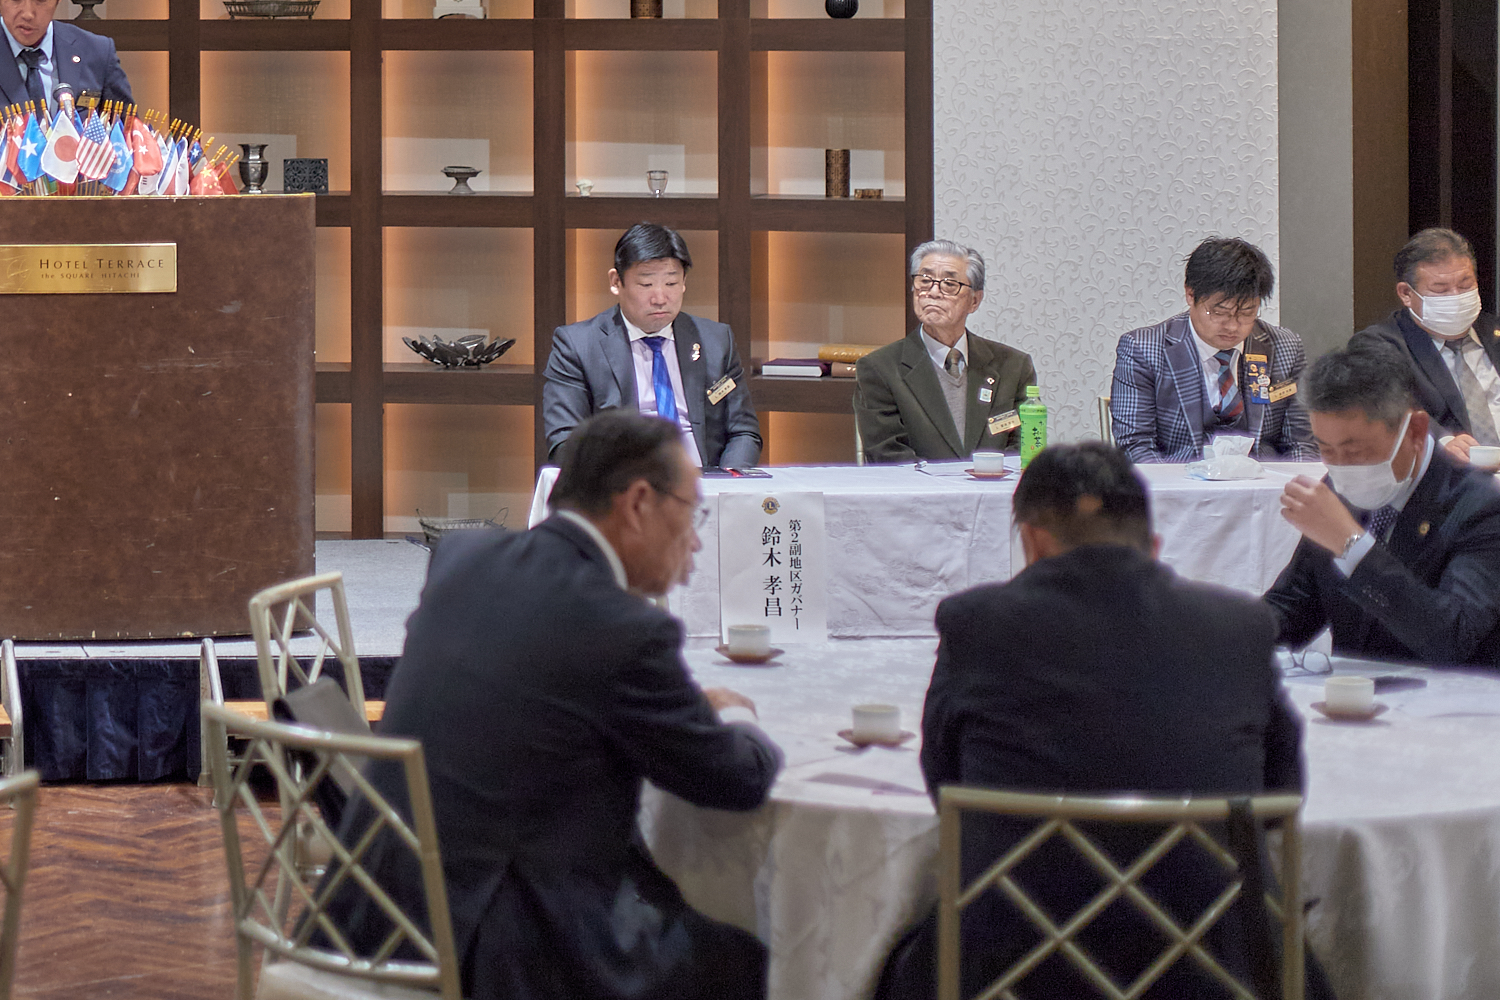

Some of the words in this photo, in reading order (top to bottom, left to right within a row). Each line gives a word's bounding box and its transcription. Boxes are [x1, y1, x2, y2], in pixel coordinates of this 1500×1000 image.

[39, 258, 88, 270] HOTEL
[96, 258, 164, 269] TERRACE
[60, 272, 94, 280] SQUARE
[762, 526, 782, 567] 鈴木
[788, 519, 803, 630] 第2副地区ガバナー
[763, 575, 782, 617] 孝昌
